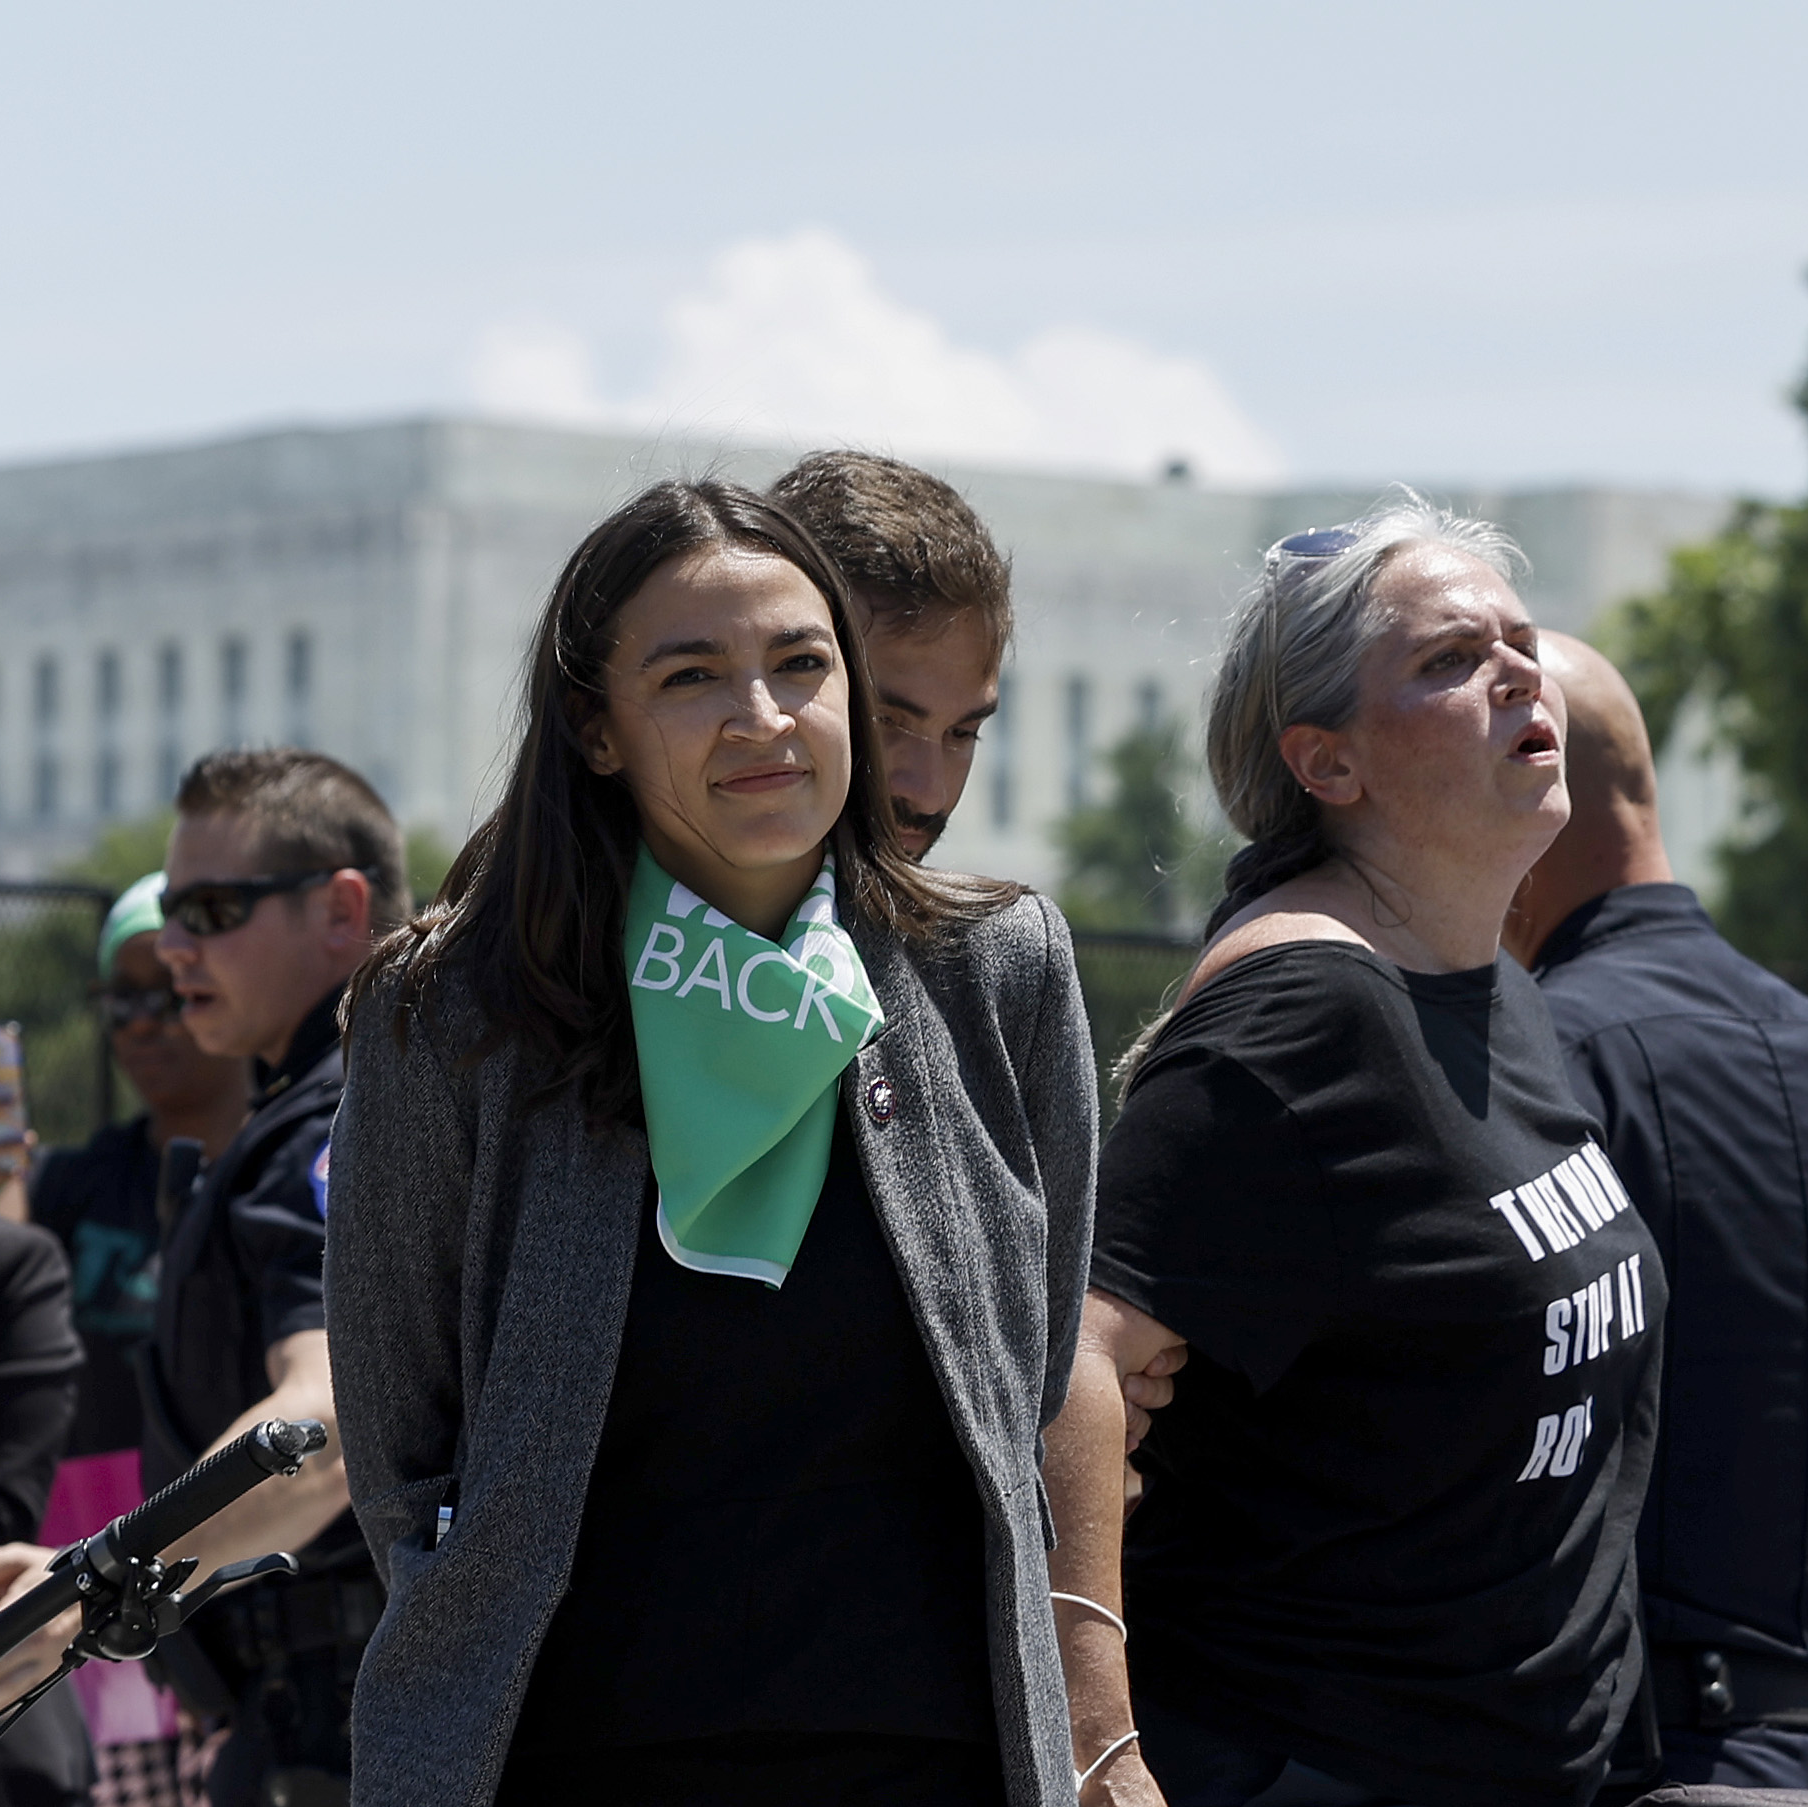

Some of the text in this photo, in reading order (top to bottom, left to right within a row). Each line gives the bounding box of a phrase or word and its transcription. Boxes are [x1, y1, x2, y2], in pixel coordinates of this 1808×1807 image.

[631, 921, 843, 1043] BACK
[1551, 1132, 1629, 1232] WON
[1543, 1253, 1645, 1377] STOP AT
[1516, 1395, 1593, 1483] RO
